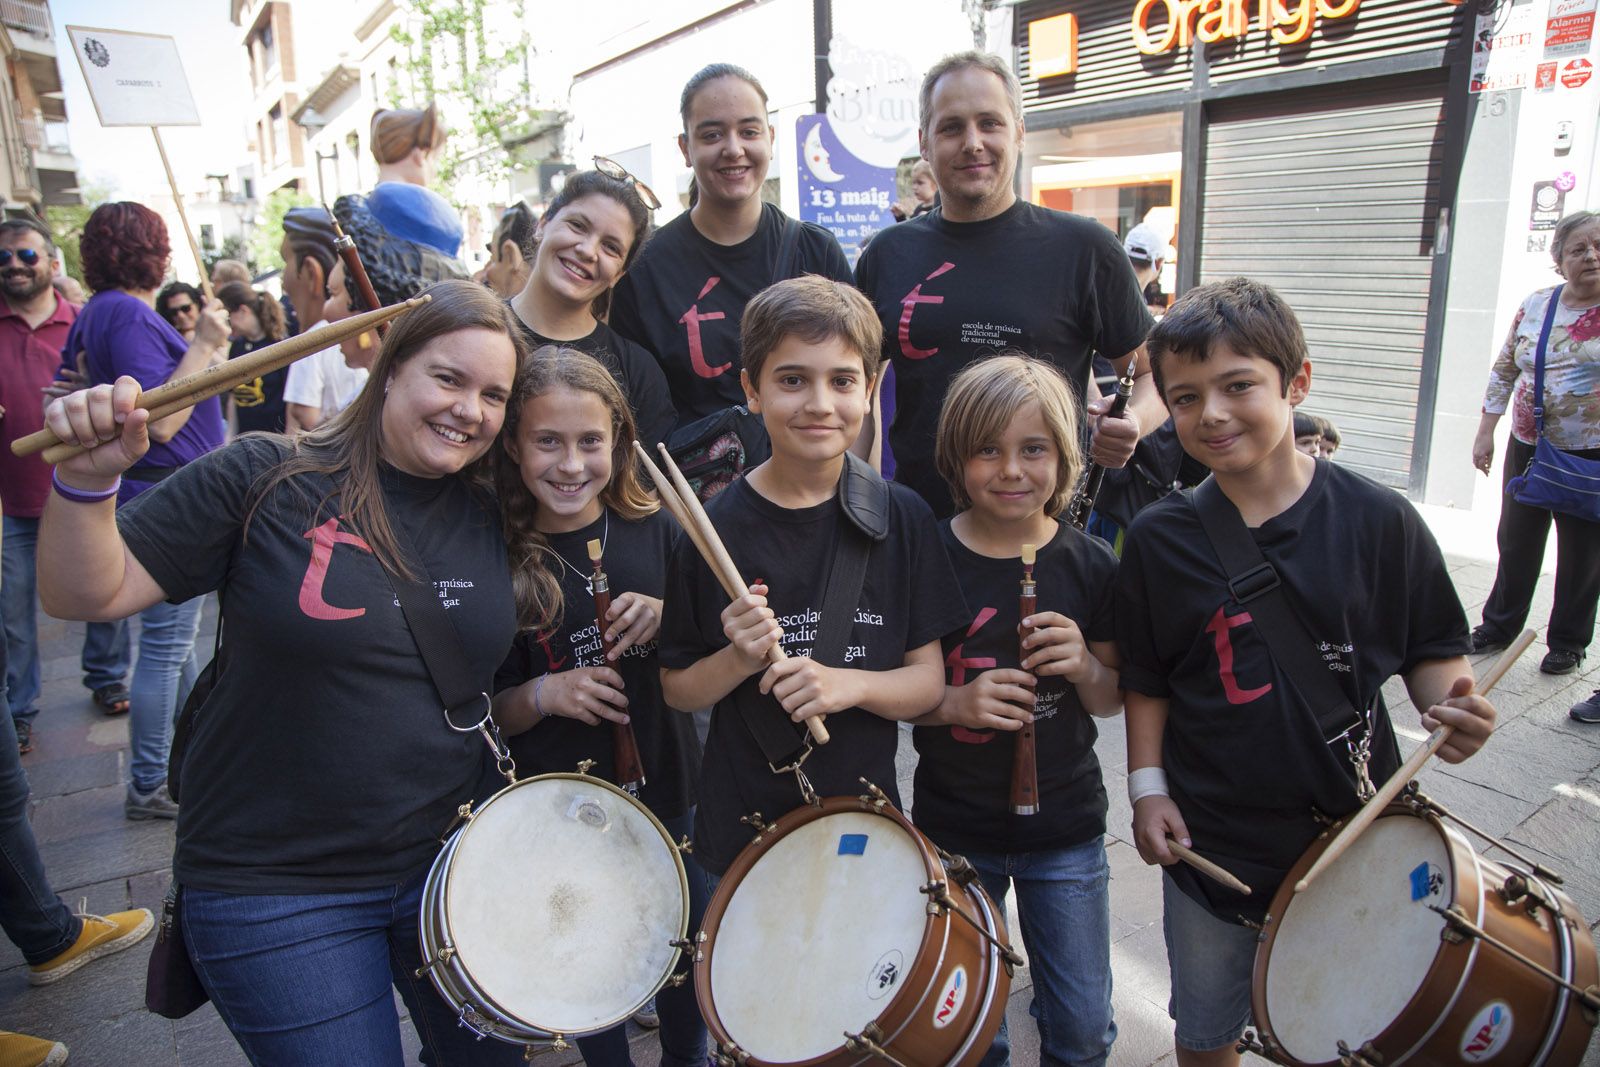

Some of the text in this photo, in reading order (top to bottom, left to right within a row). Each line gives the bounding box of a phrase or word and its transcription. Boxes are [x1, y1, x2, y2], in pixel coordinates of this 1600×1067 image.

[1550, 15, 1591, 28] Alarma
[811, 187, 890, 209] 13 maig
[961, 328, 1000, 338] tradicional
[962, 321, 1022, 334] escola de música
[960, 335, 970, 343] de
[439, 578, 475, 588] música
[442, 598, 460, 610] gat
[854, 608, 884, 626] úsica
[569, 618, 601, 643] escol
[1320, 640, 1353, 653] de mús
[844, 645, 866, 662] gat
[574, 657, 590, 669] de
[936, 989, 956, 1024] NP
[1464, 1024, 1494, 1060] NP
